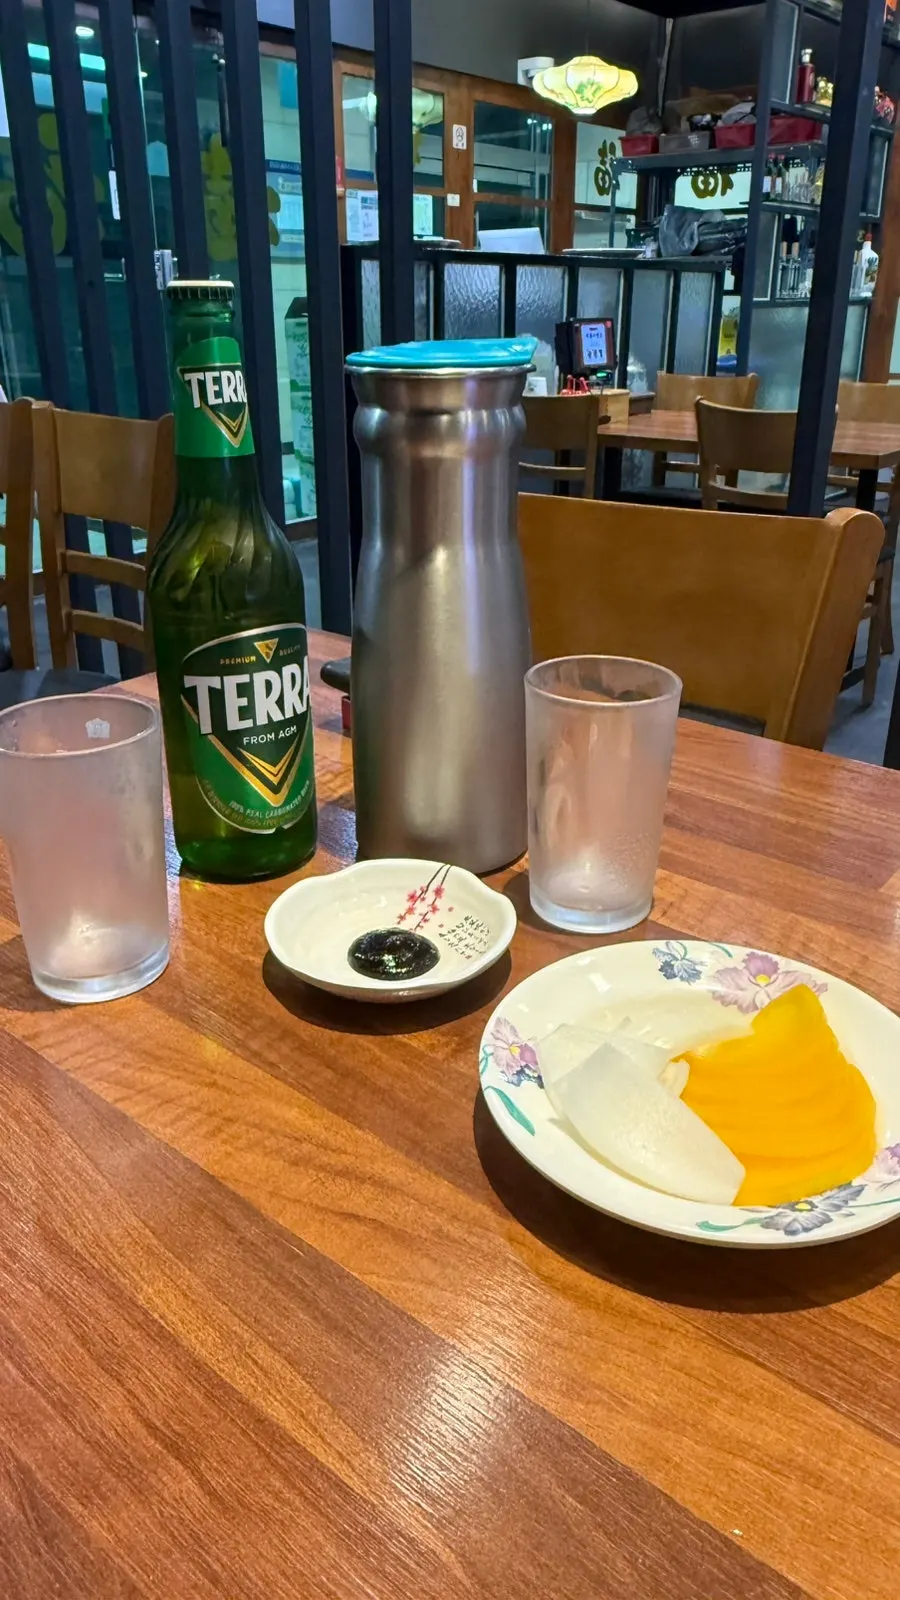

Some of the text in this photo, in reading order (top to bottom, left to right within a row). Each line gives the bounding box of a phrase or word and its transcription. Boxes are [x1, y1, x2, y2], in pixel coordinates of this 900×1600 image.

[219, 655, 257, 665] PREMIUM
[183, 655, 311, 735] TERRA
[243, 724, 297, 746] FROM AGM
